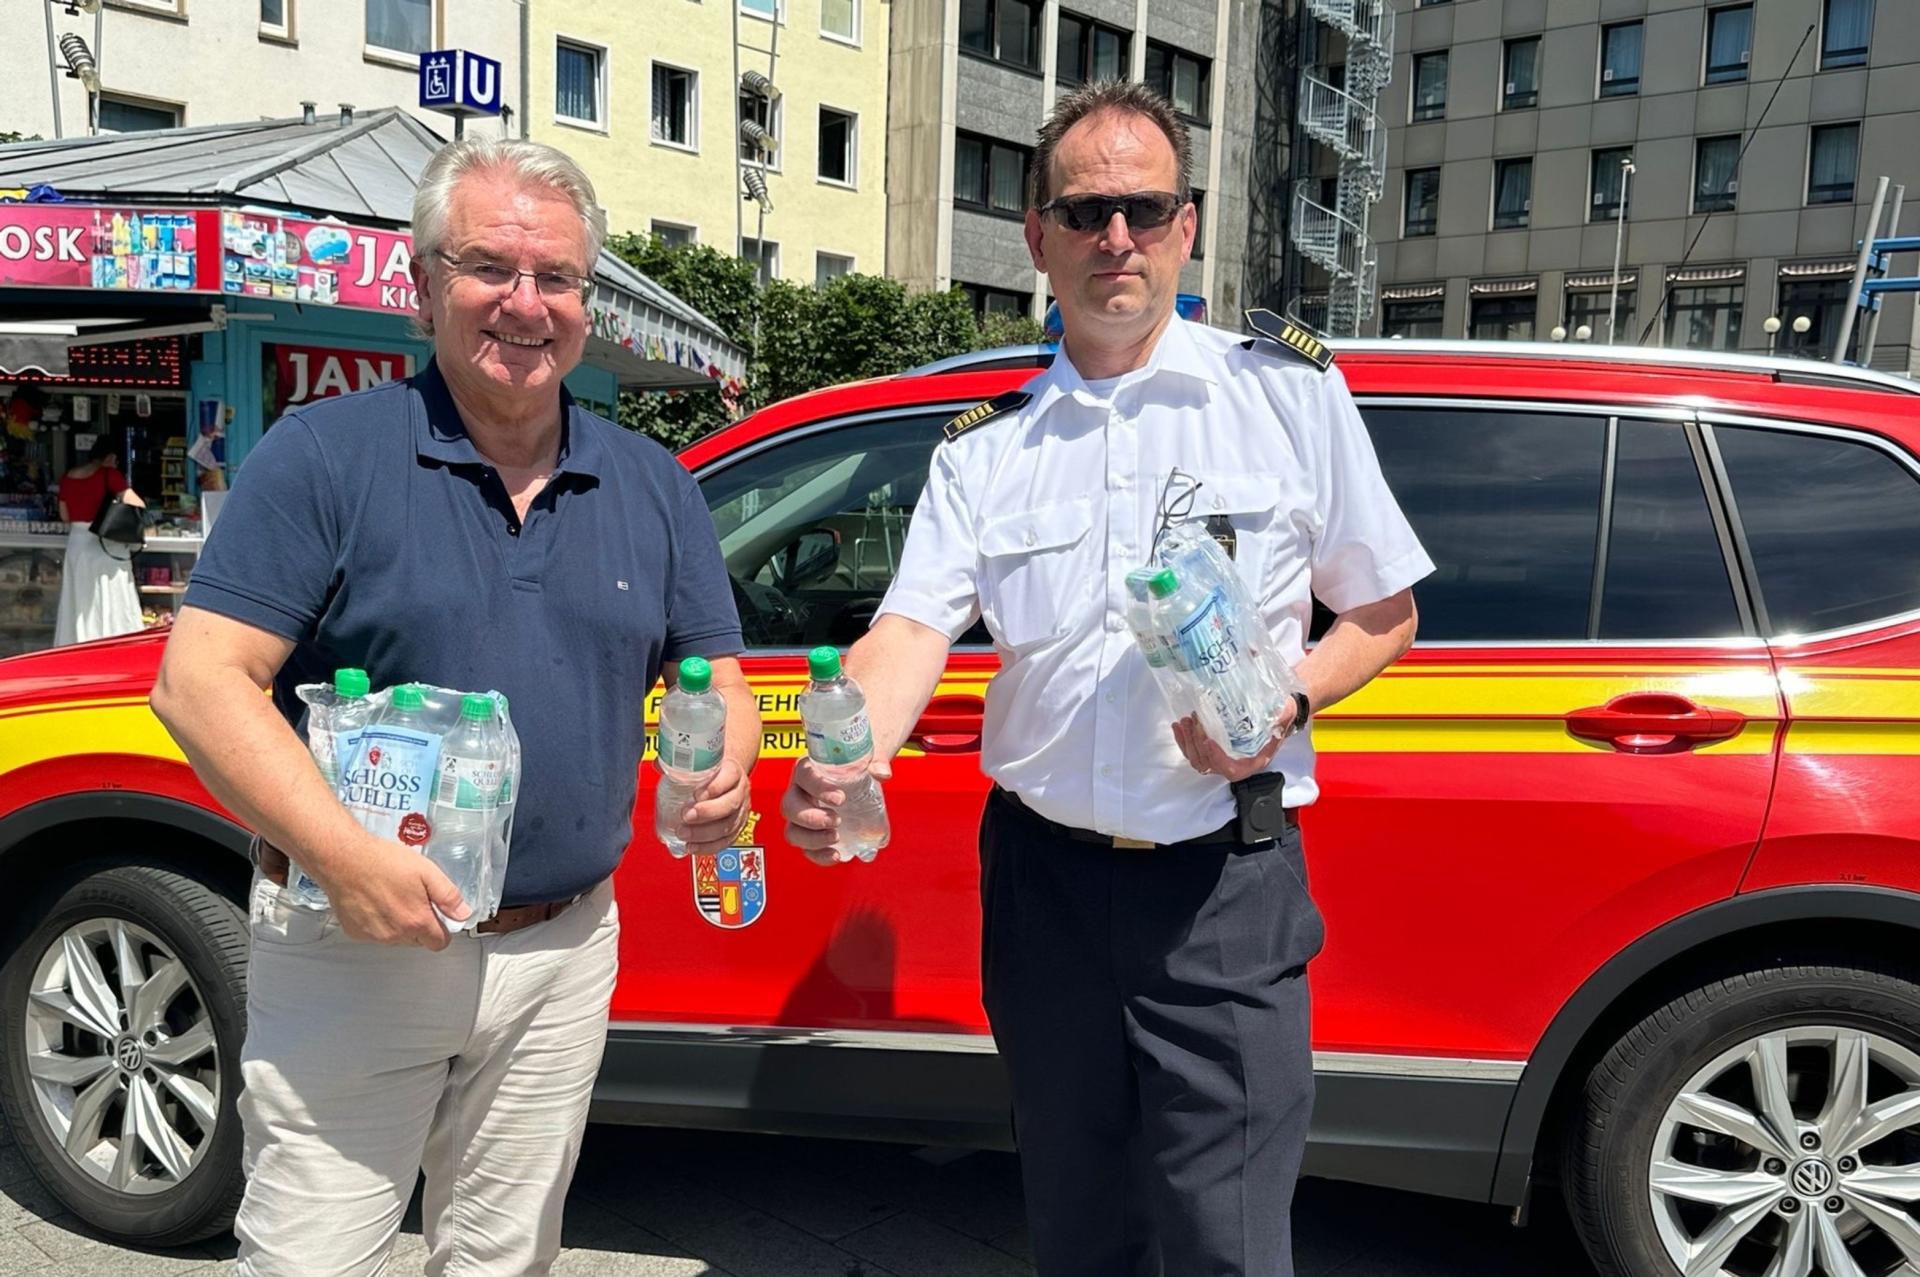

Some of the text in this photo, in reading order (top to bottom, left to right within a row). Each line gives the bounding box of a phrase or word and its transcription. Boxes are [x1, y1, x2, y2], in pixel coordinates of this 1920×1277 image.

[469, 58, 494, 104] U
[353, 234, 415, 287] JA
[764, 732, 808, 750] RUH
